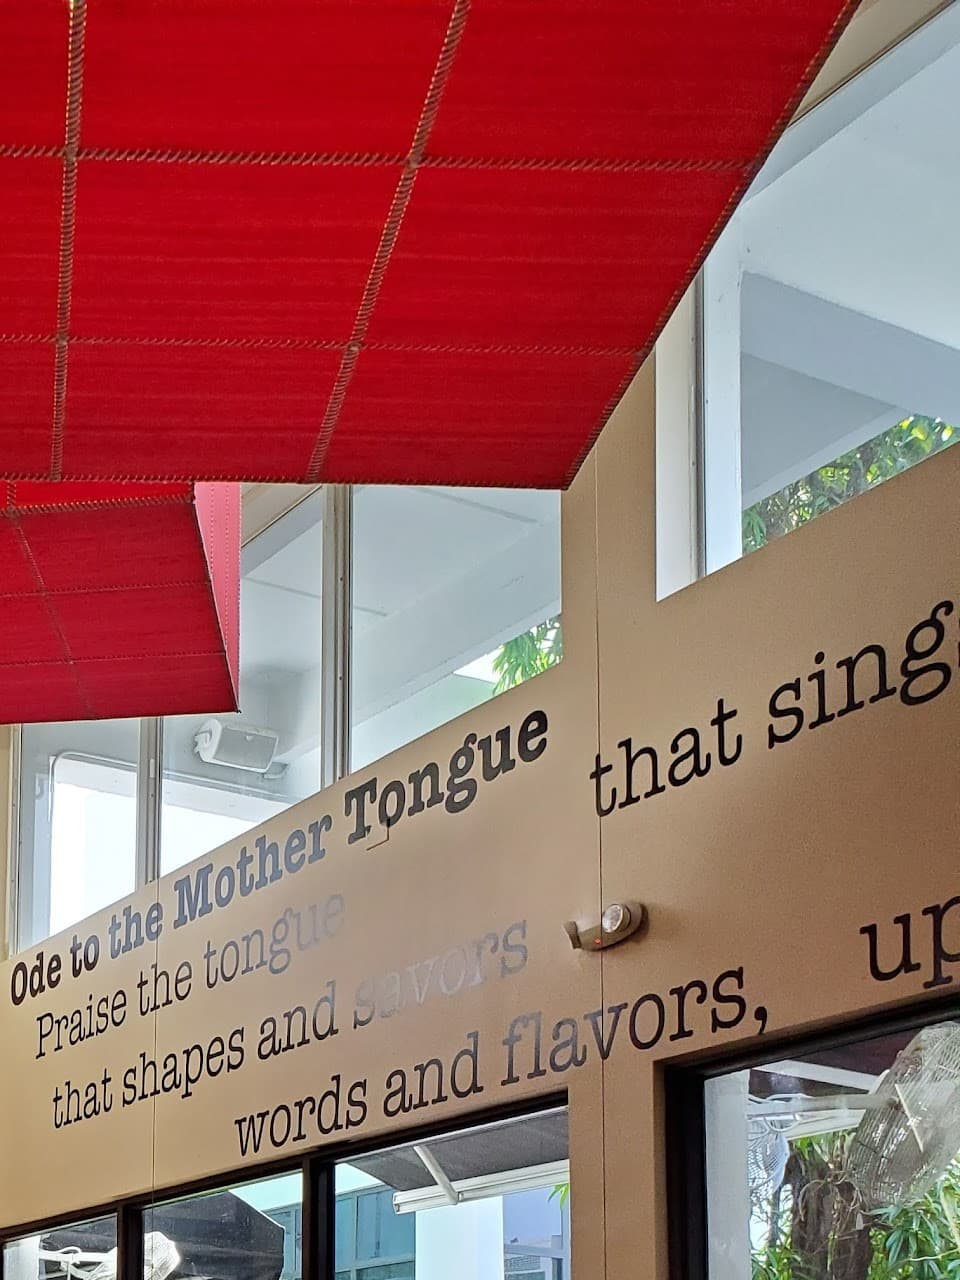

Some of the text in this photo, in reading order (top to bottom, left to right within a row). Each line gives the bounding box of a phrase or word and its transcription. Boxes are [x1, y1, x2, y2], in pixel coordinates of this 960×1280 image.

[590, 600, 960, 817] that sing
[11, 710, 548, 1006] Ode to the Mother Tongue
[859, 895, 960, 989] up
[35, 893, 345, 1060] Praise the tongue
[53, 919, 528, 1129] that shapes and savors
[234, 966, 768, 1157] words and flavors,
